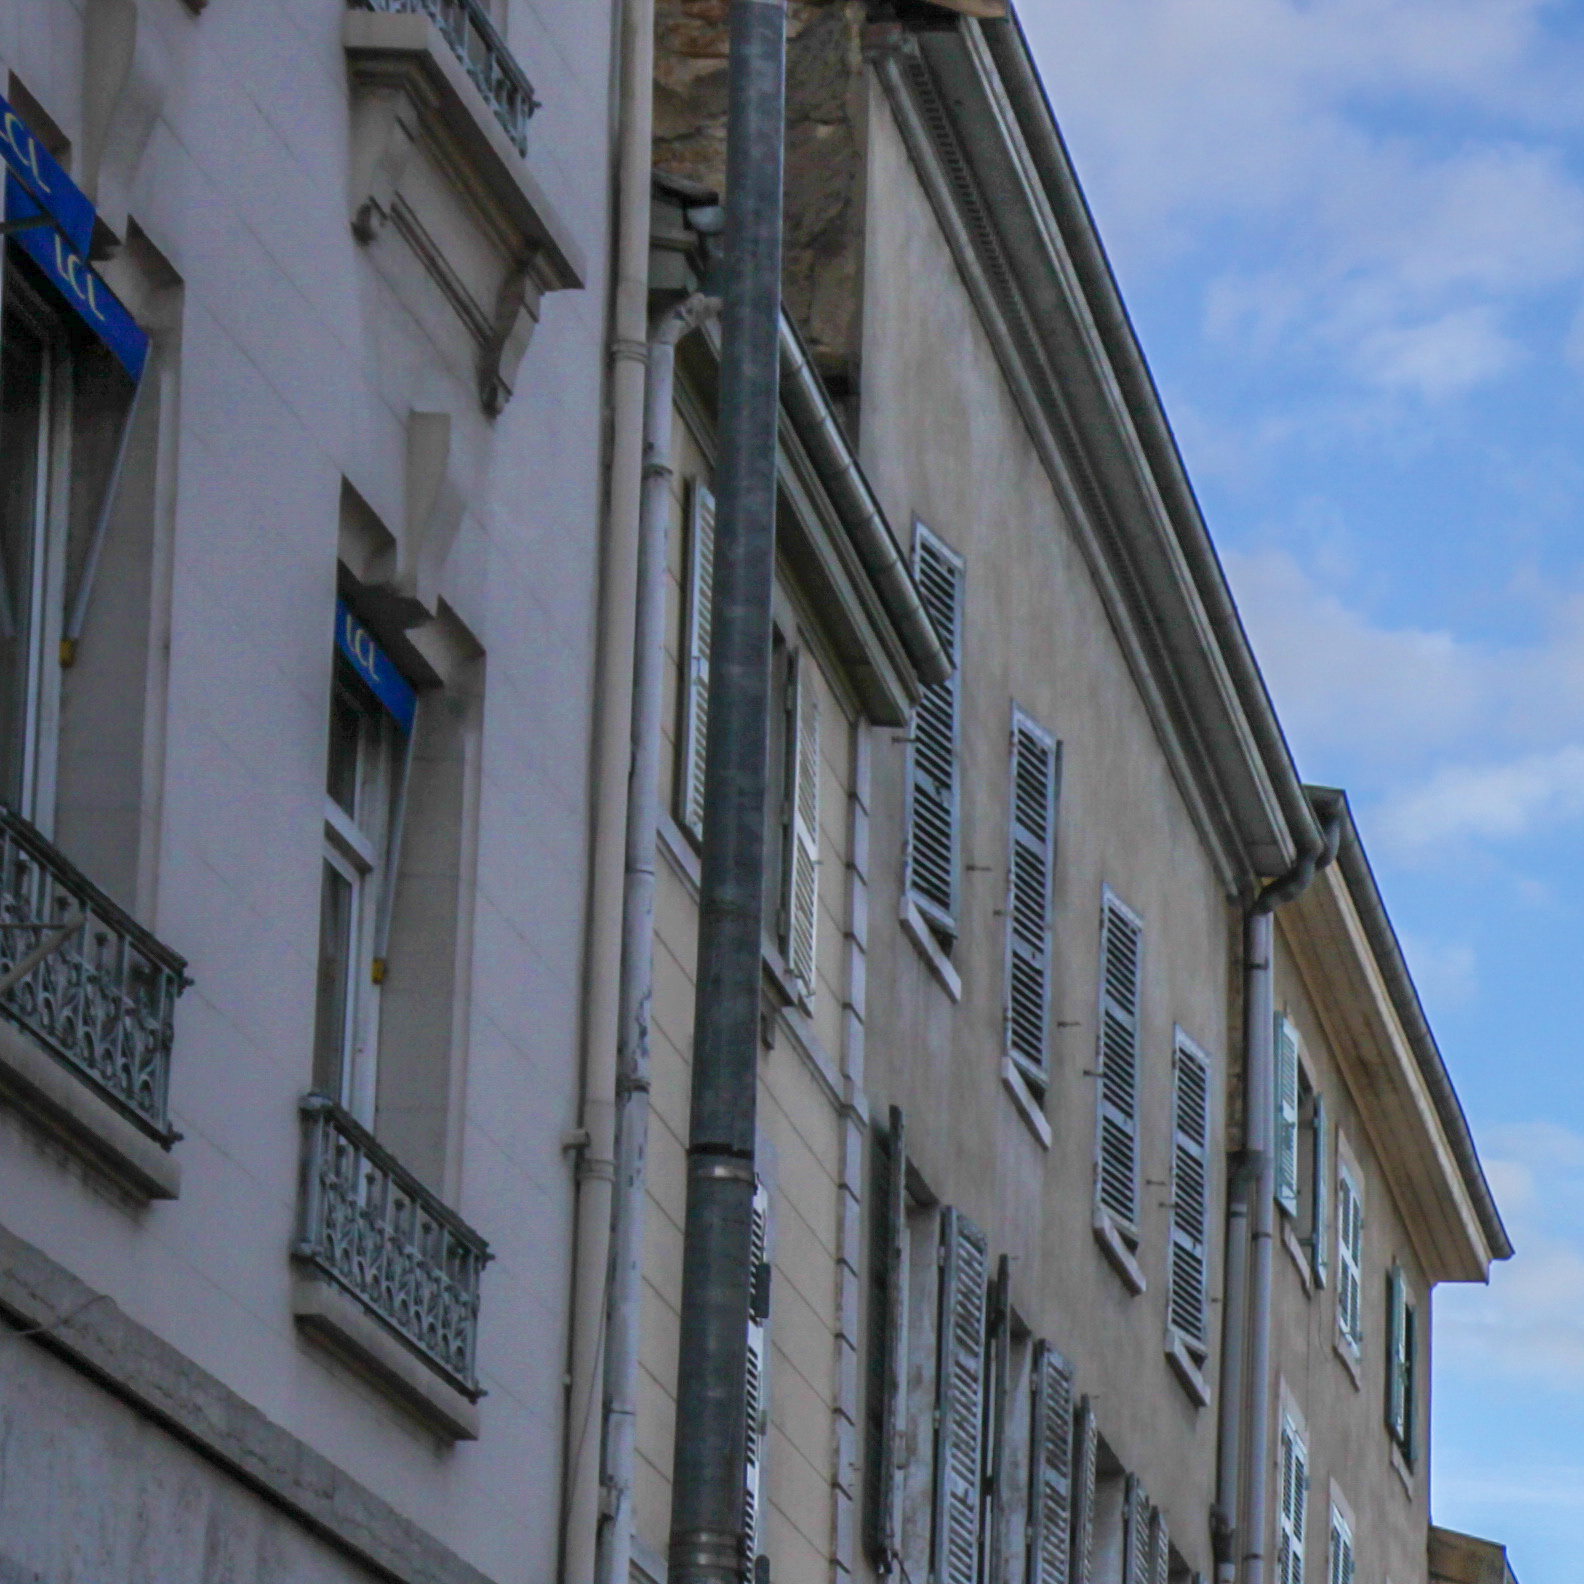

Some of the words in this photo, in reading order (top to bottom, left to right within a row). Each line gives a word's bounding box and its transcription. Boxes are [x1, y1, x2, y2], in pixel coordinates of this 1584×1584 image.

[0, 112, 51, 194] CL
[54, 233, 105, 321] LCL
[346, 613, 381, 684] LCL
